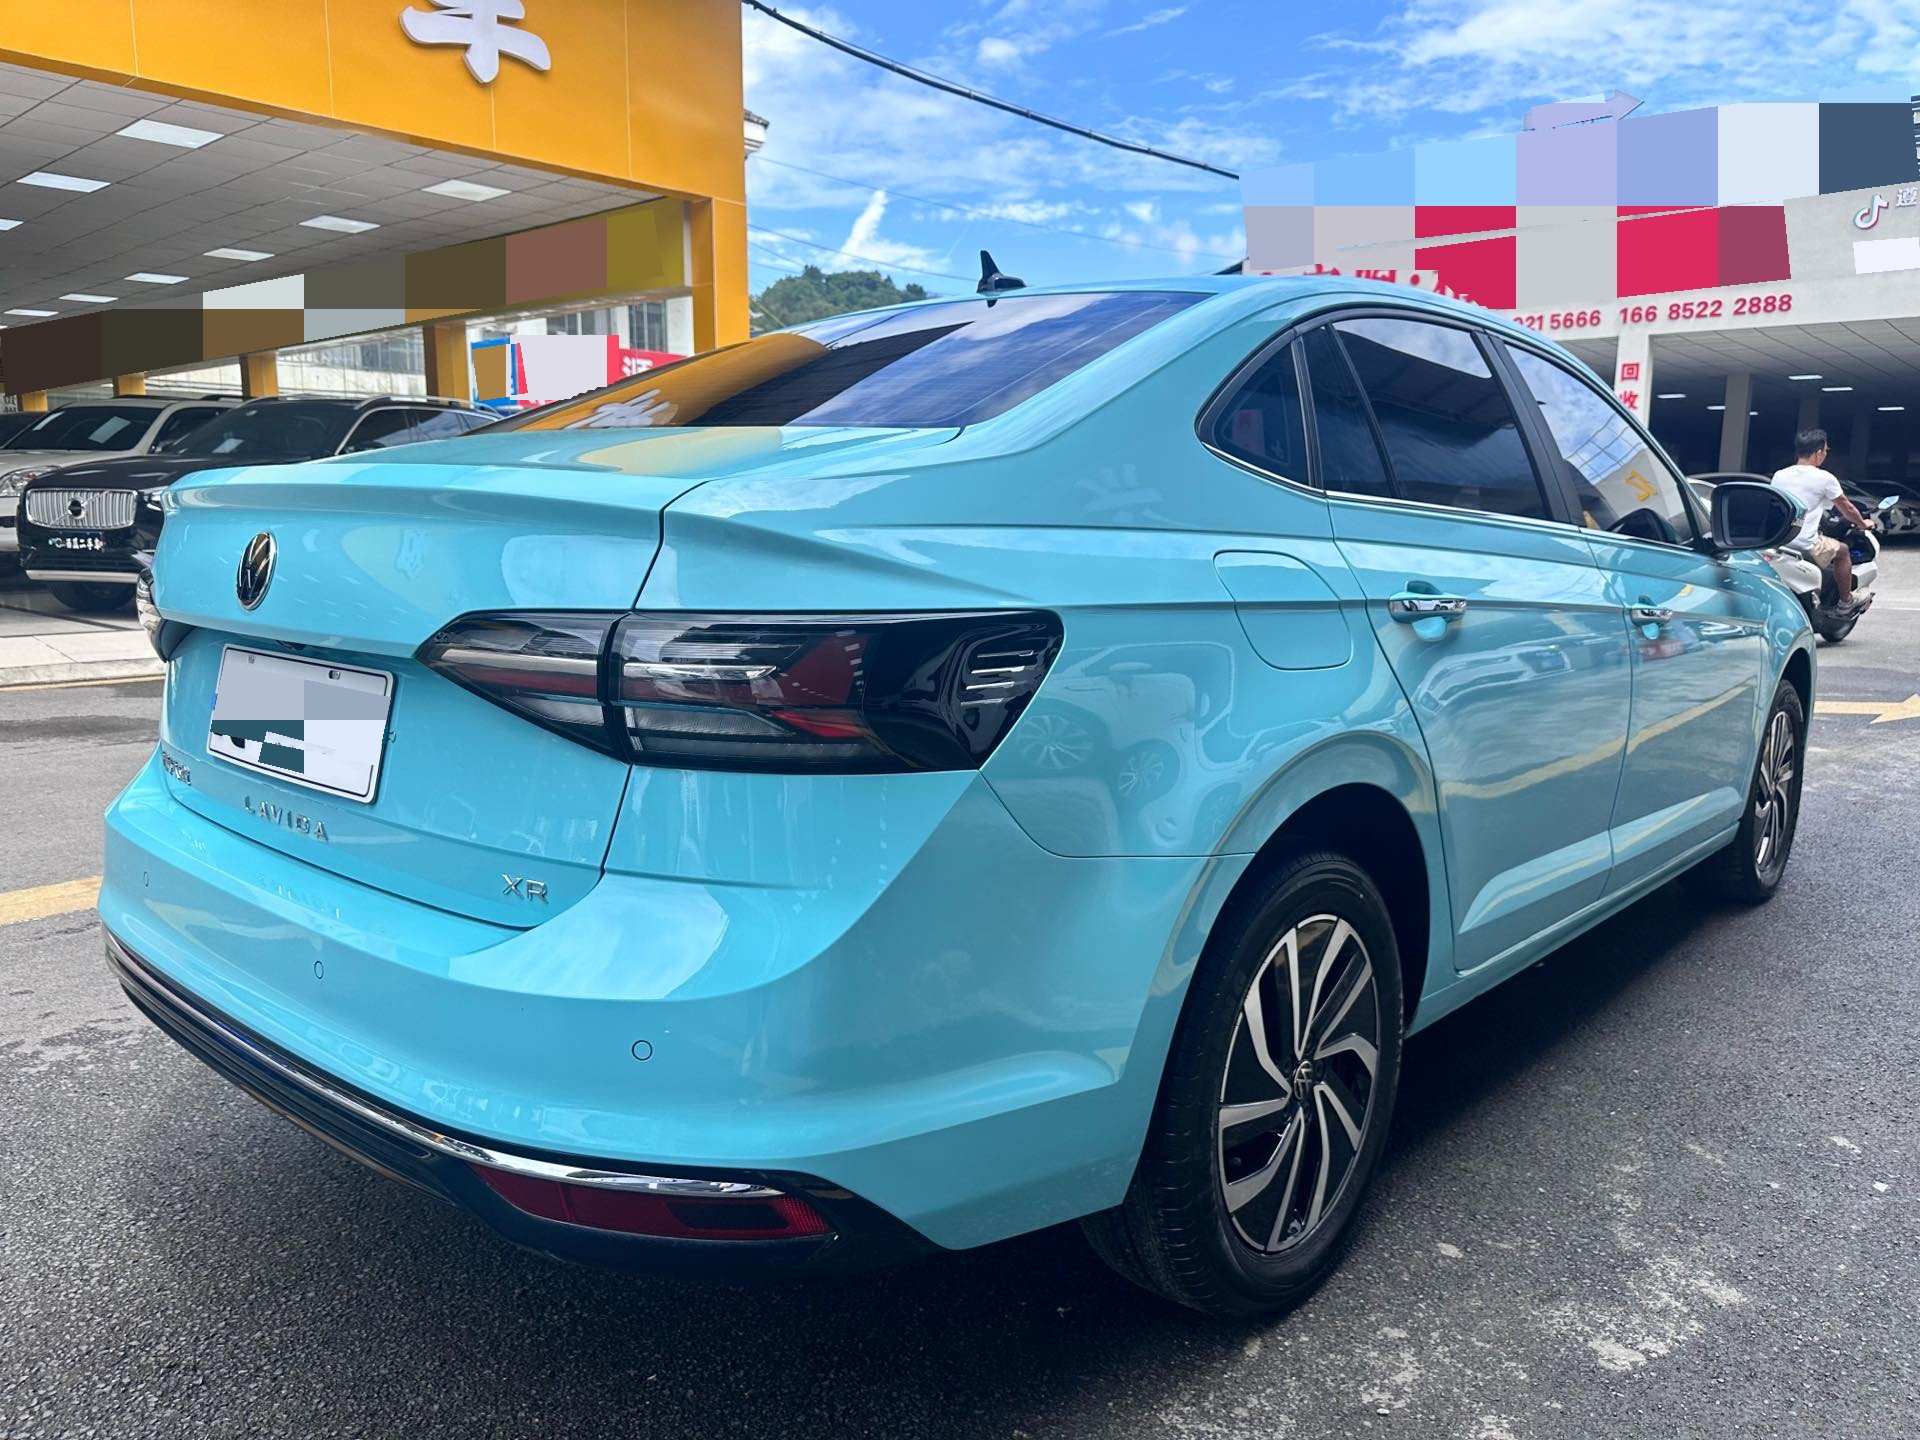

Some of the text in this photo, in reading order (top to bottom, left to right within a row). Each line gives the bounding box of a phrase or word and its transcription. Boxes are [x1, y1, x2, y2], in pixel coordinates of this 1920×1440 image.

[1550, 310, 1602, 330] 5666
[1619, 305, 1657, 324] 166
[1668, 300, 1722, 320] 8522
[1733, 294, 1792, 315] 2888
[244, 796, 329, 842] LAVIDA
[502, 873, 549, 905] XR
